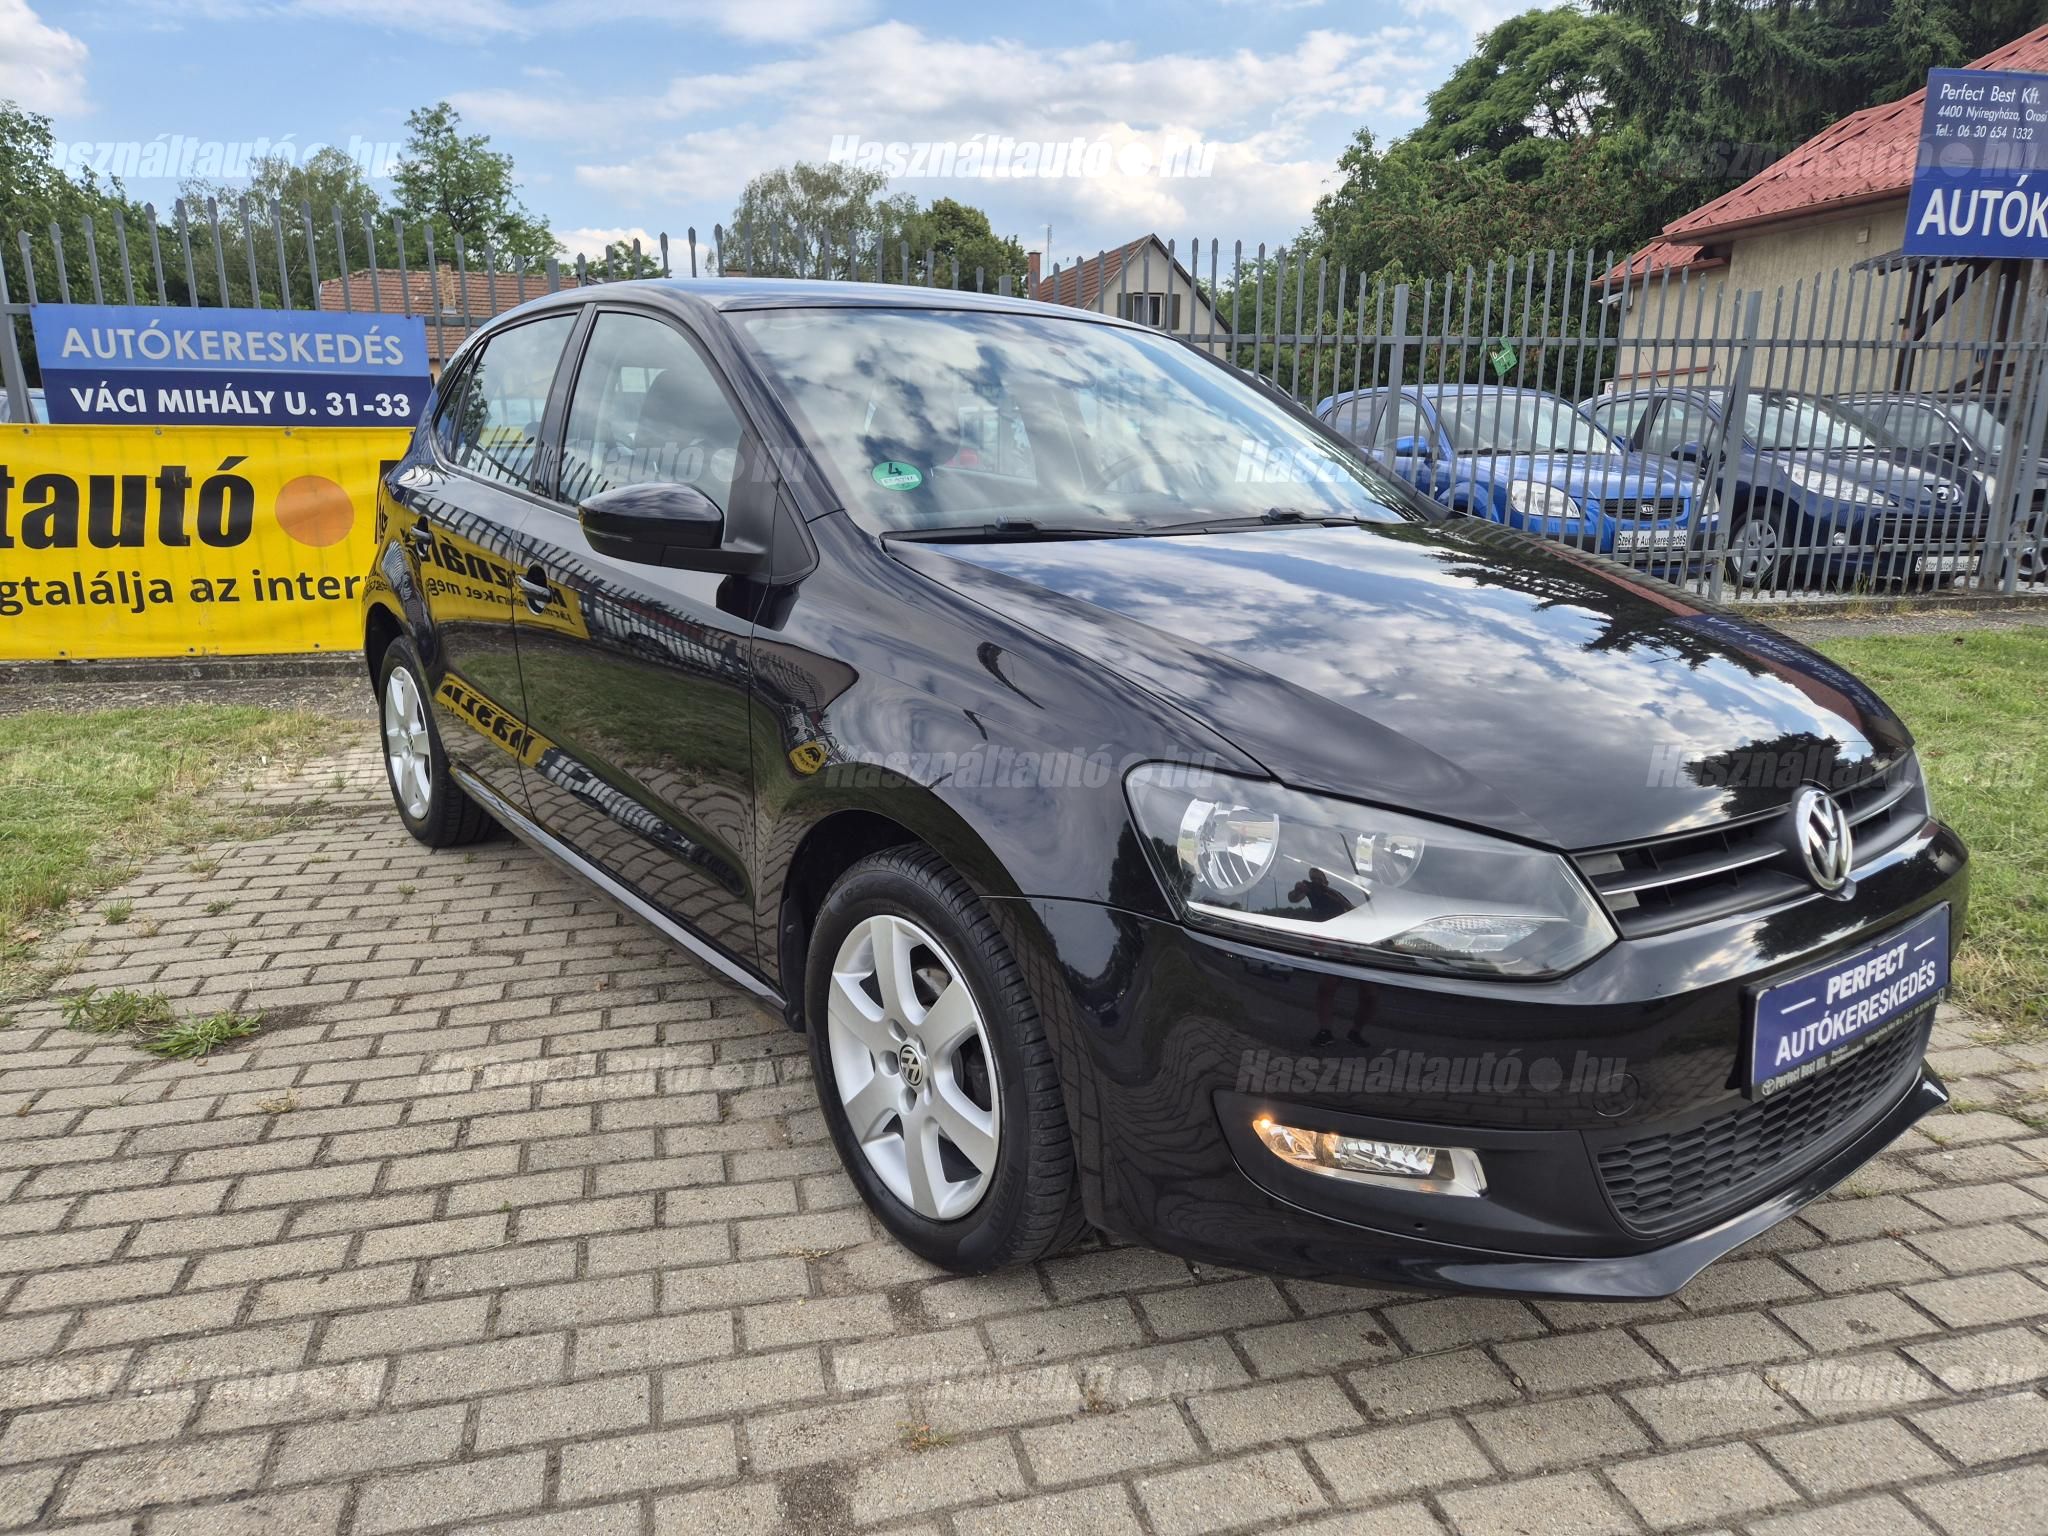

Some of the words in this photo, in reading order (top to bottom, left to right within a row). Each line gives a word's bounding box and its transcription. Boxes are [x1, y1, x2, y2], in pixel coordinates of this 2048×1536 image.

[1940, 83, 1984, 102] Perfect
[1991, 86, 2017, 103] Best
[2021, 87, 2041, 105] Kft.
[1935, 124, 1953, 137] Tel.:
[1957, 125, 1970, 138] 06
[1973, 125, 1987, 138] 30
[1990, 126, 2007, 139] 654
[2012, 127, 2033, 141] 1332
[1937, 105, 1963, 118] 4400
[1966, 106, 2021, 123] Nyíregyháza,
[61, 319, 405, 366] AUTÓKERESKEDÉS
[71, 380, 147, 414] VÁCI
[157, 382, 275, 416] MIHÁLY
[285, 392, 317, 416] U.
[325, 393, 411, 417] 31-33
[888, 463, 903, 476] 4
[0, 571, 174, 616] gtalálja
[189, 578, 240, 603] az
[252, 569, 370, 601] inter
[1826, 942, 1908, 1005] PERFECT
[1775, 960, 1936, 1067] AUTÓKERESKEDÉS
